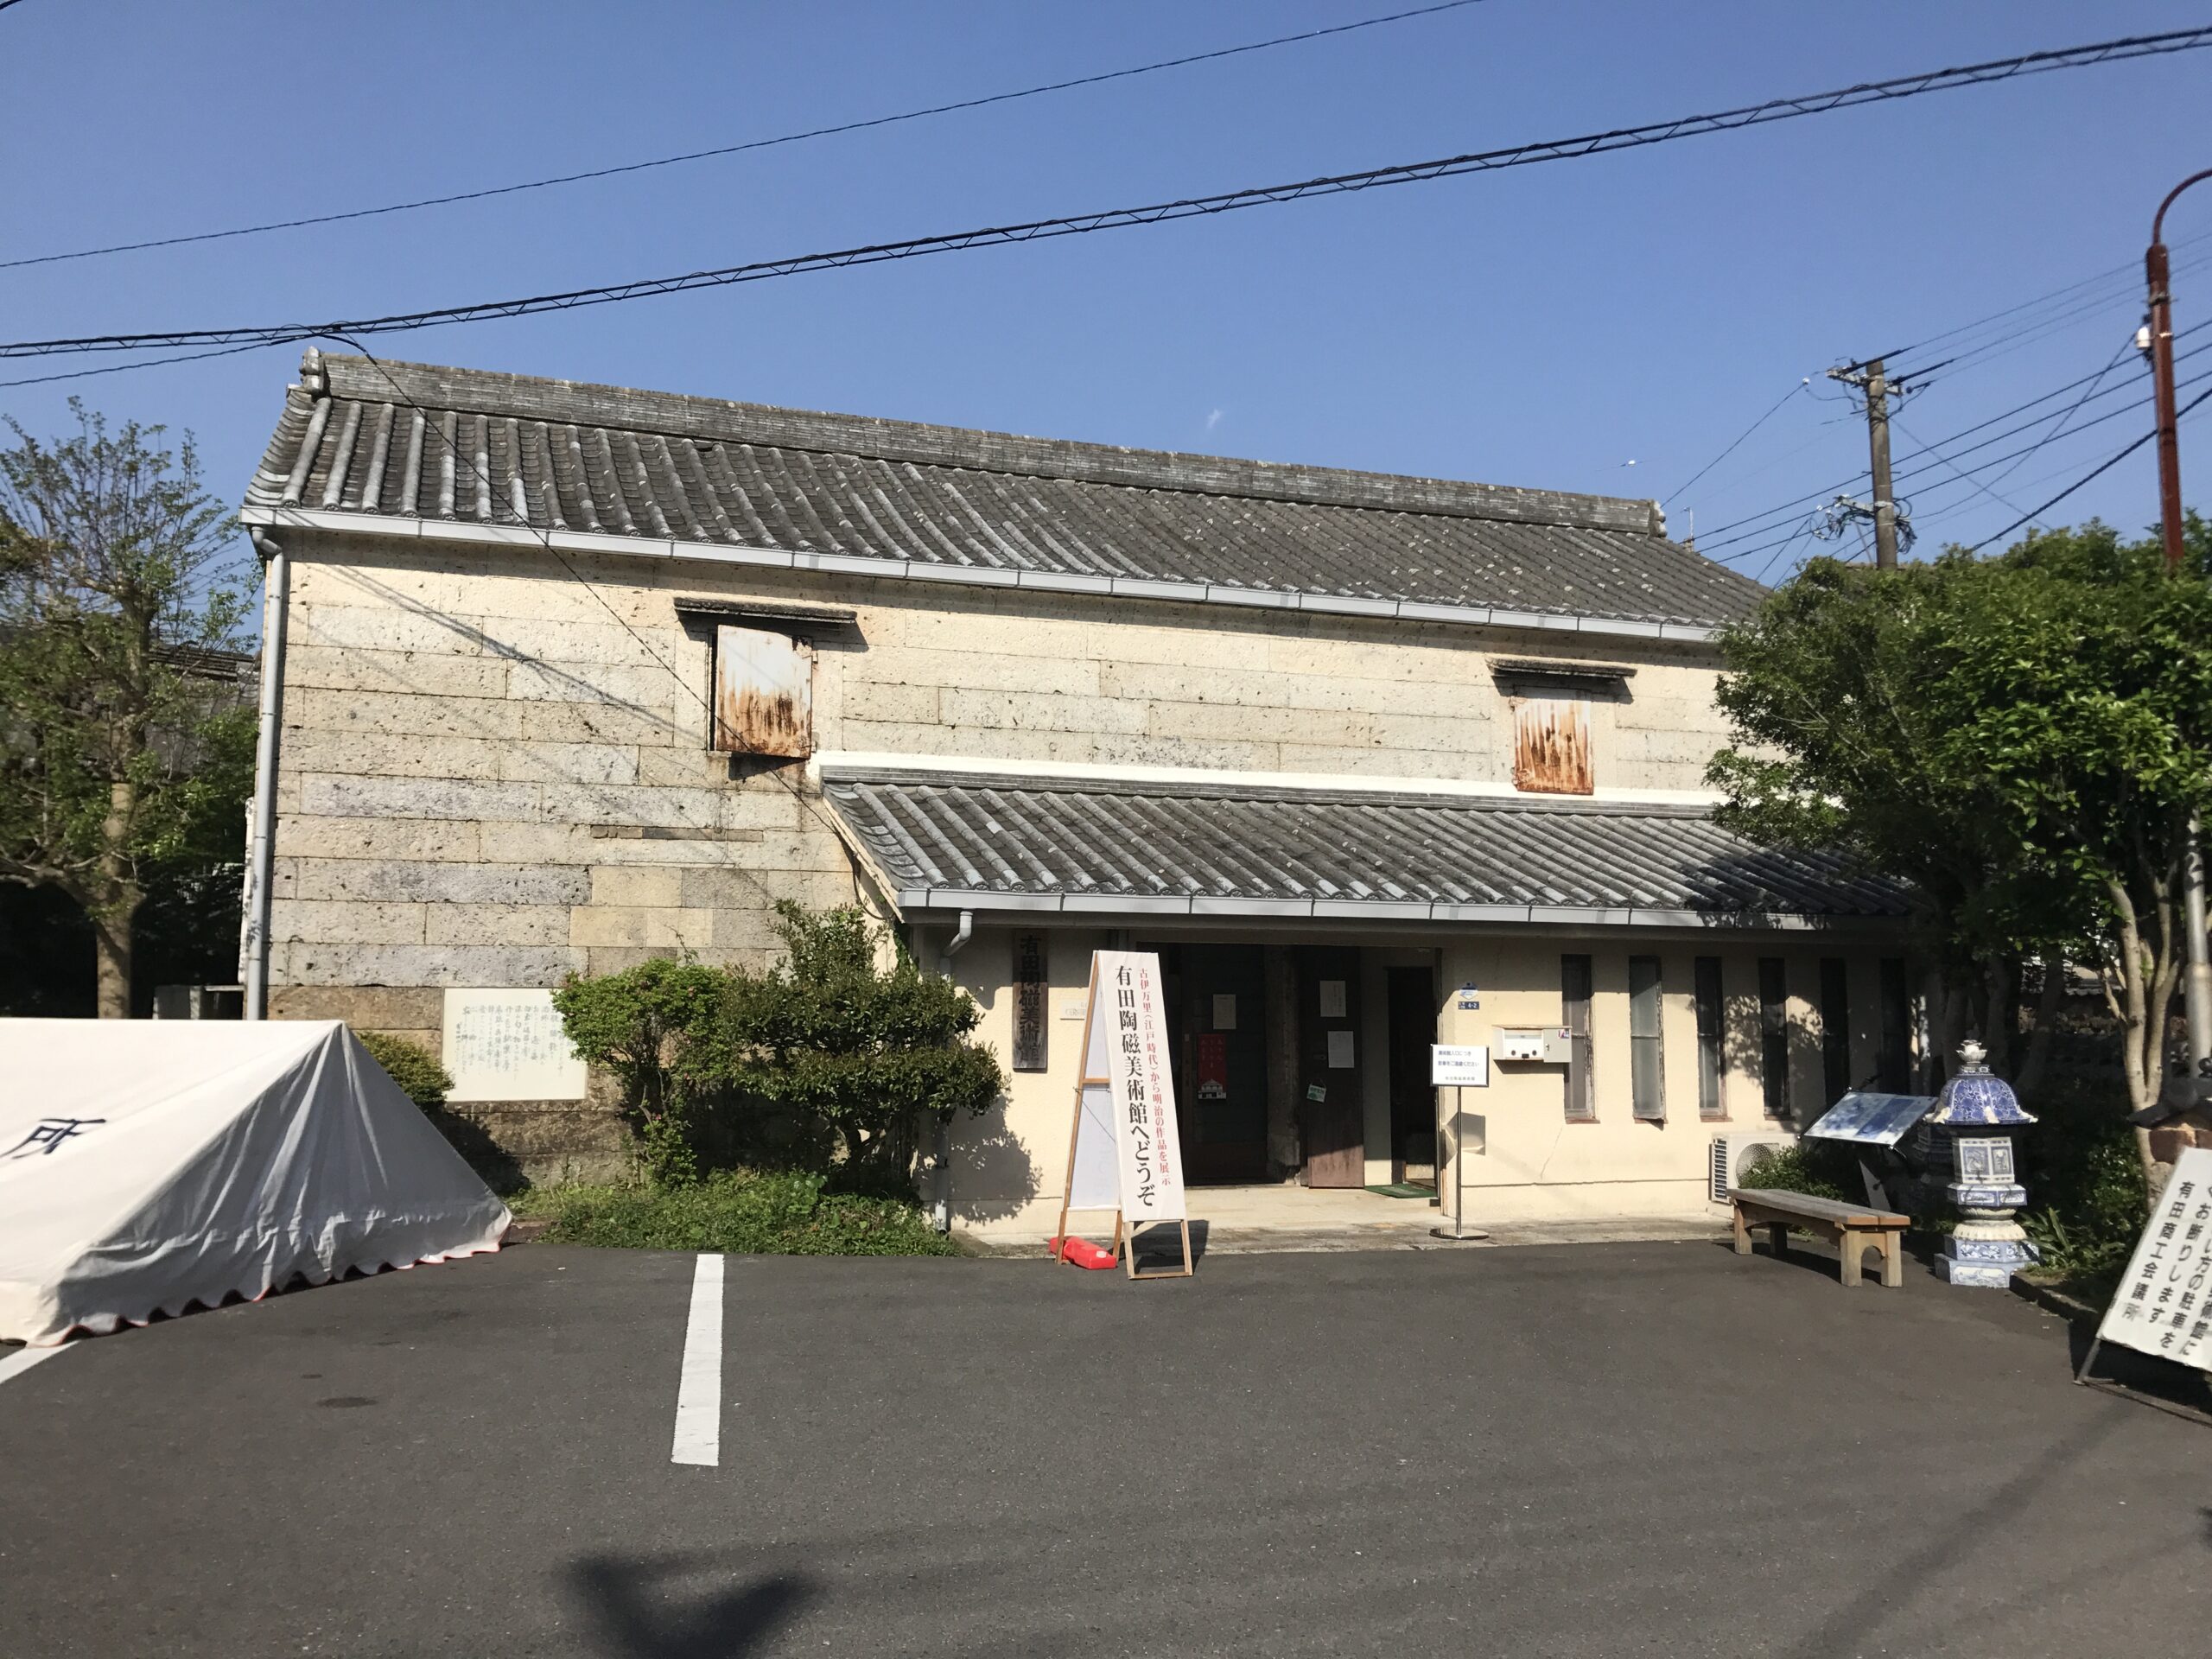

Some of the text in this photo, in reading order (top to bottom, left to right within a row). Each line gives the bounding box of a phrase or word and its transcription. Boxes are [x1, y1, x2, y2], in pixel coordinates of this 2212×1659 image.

[0, 1118, 107, 1160] 所
[1116, 965, 1155, 1207] 有田陶磁美術館へどうぞ
[2122, 1181, 2196, 1322] 有田商工会議所
